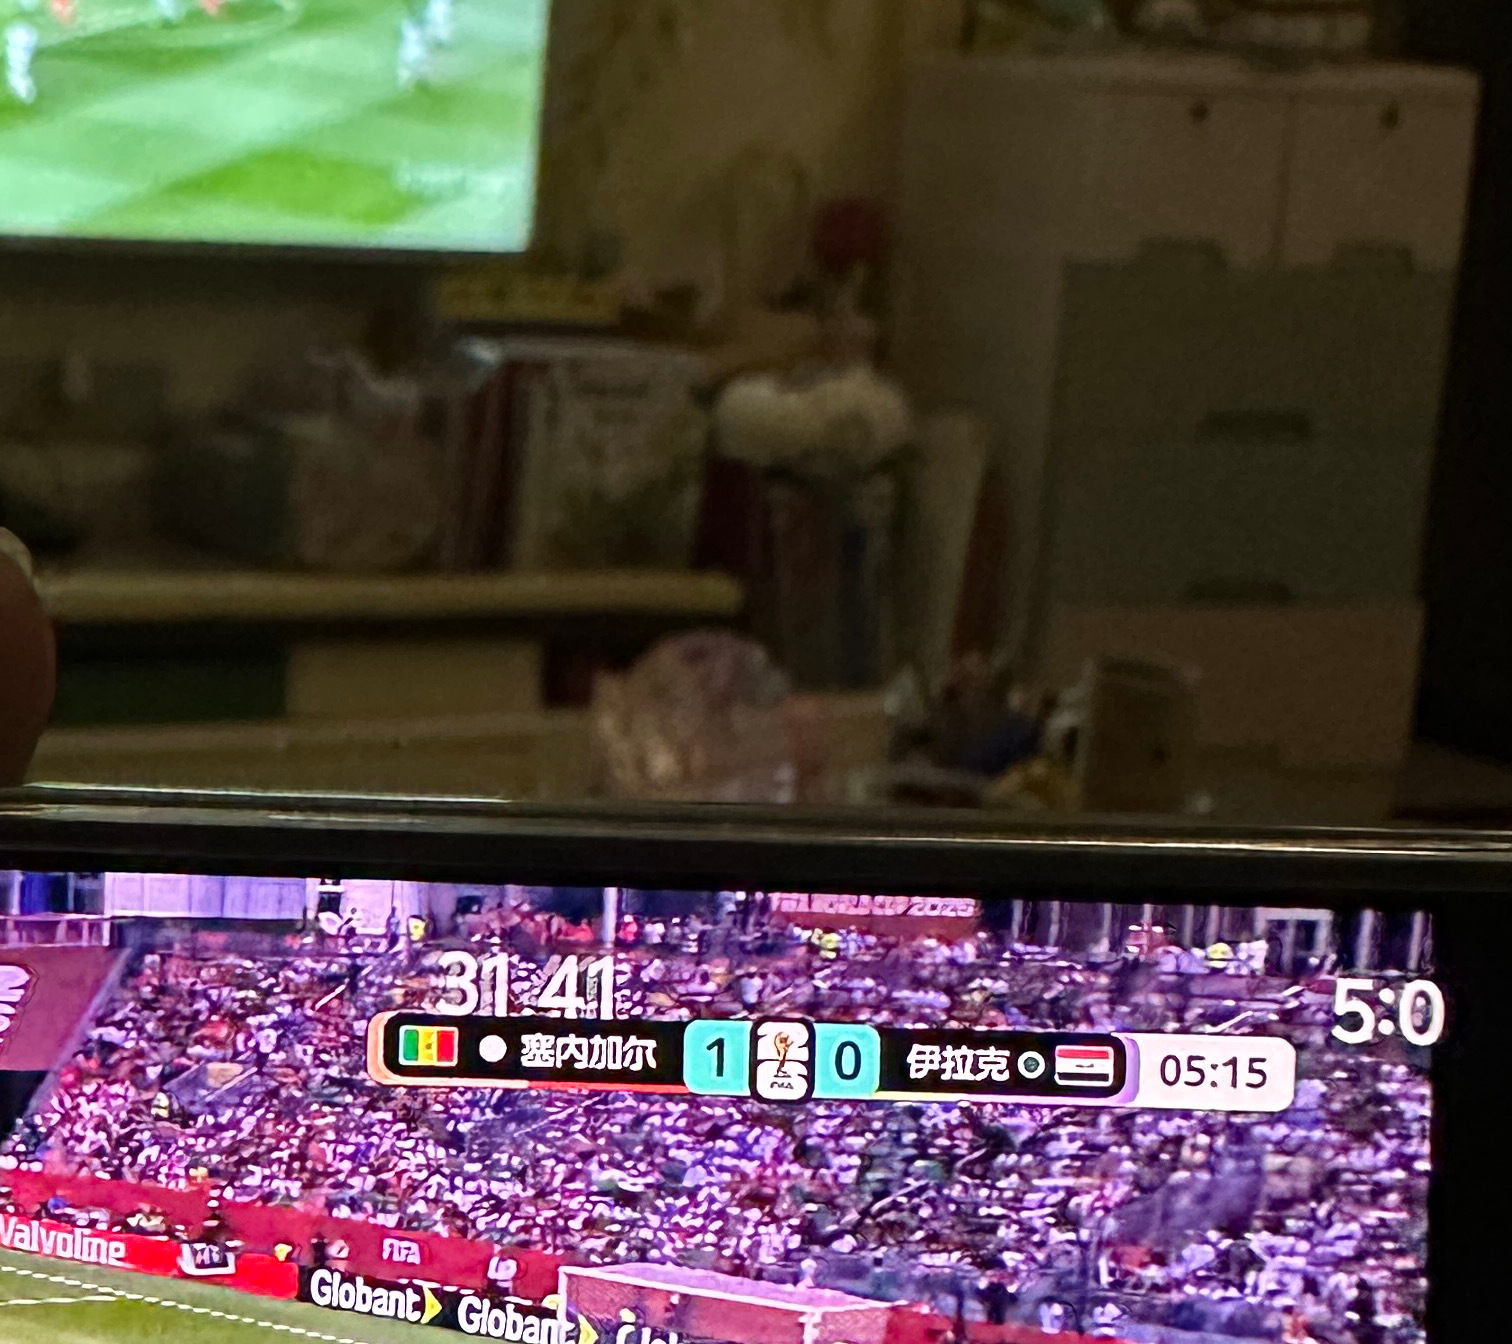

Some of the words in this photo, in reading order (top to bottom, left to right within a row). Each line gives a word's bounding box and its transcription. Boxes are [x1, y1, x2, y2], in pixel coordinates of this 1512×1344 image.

[1331, 978, 1445, 1046] 5:0
[520, 1033, 657, 1071] 塞内加尔
[706, 1037, 725, 1078] 1
[834, 1040, 862, 1081] 0
[906, 1043, 1010, 1082] 伊拉克
[1159, 1055, 1268, 1090] 05:15
[310, 1269, 423, 1324] Globant
